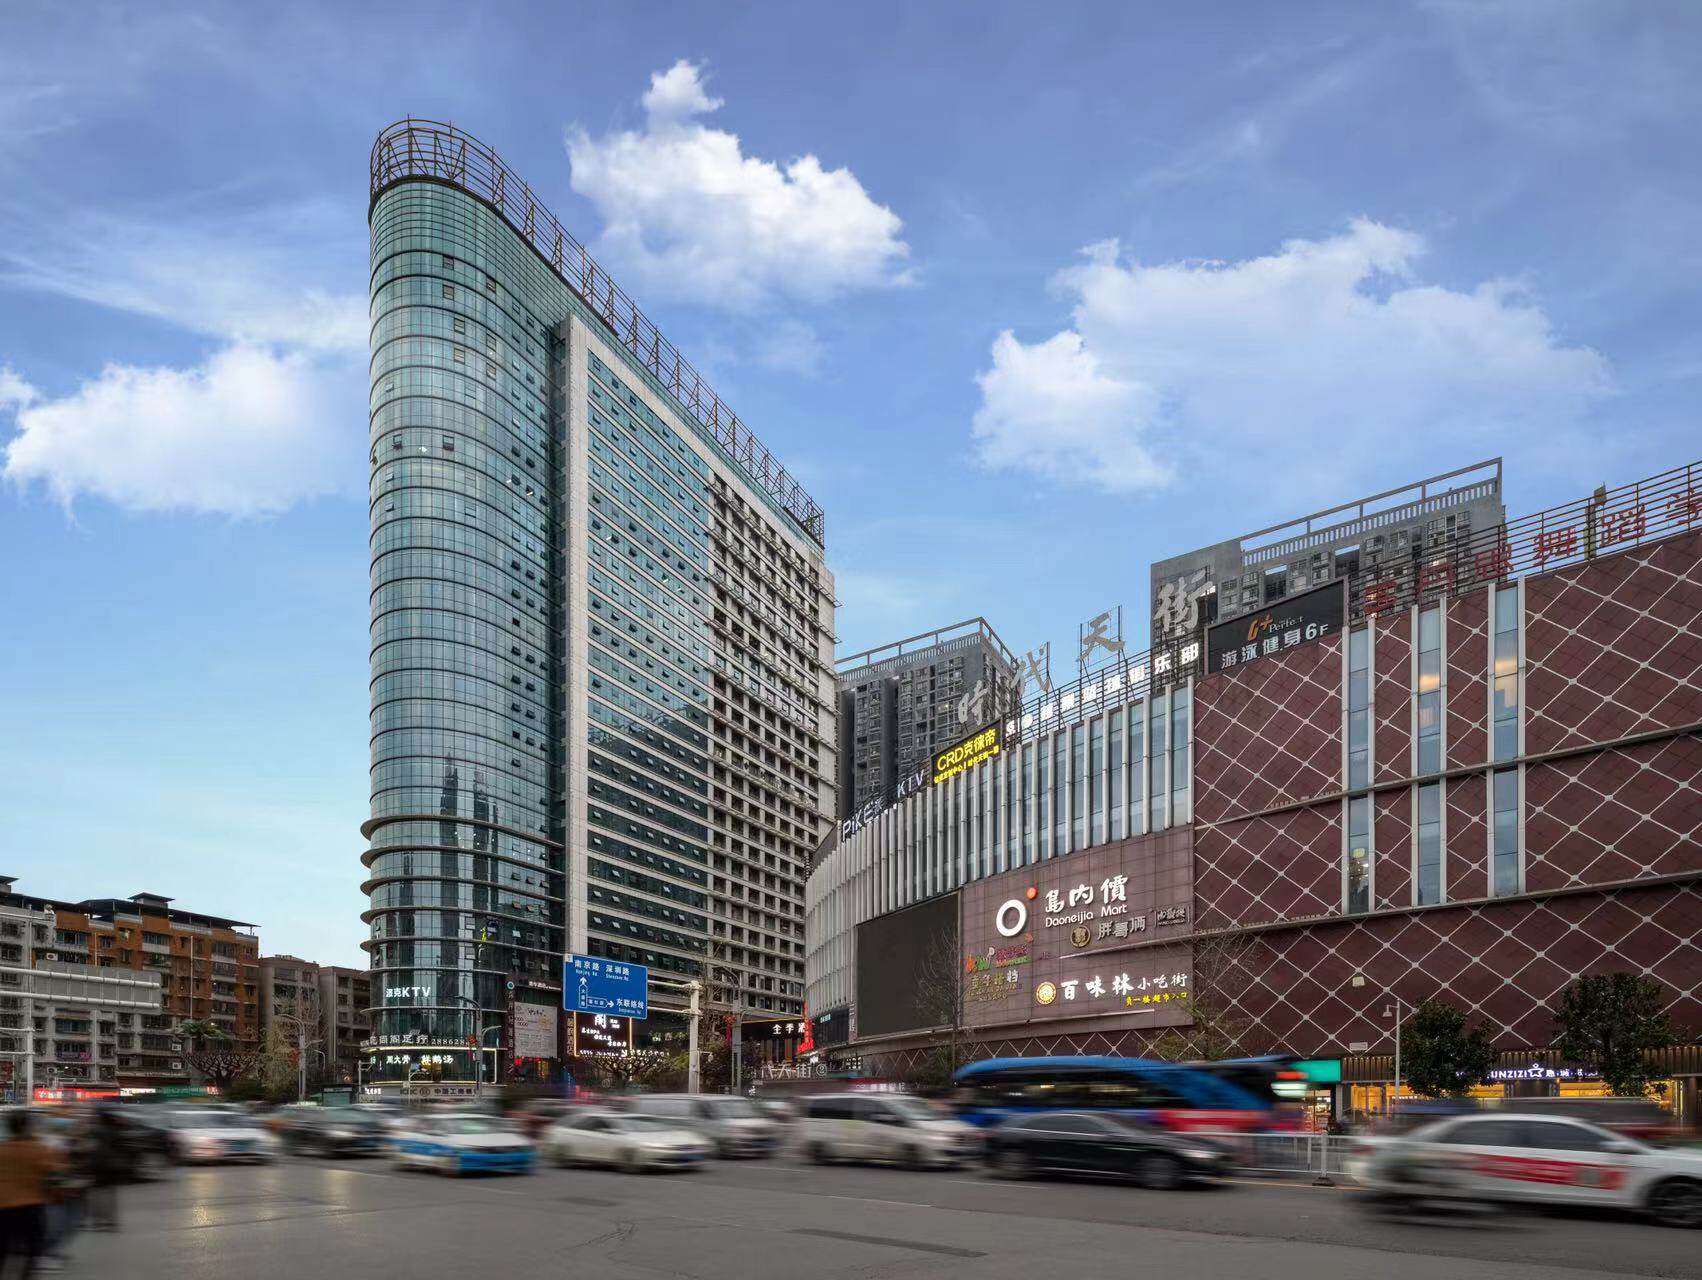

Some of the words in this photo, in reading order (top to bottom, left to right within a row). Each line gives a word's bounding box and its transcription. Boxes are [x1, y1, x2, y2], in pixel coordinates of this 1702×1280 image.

[897, 769, 925, 798] KTV
[1045, 911, 1094, 928] Daoneijia
[1100, 904, 1128, 918] Mart
[574, 960, 600, 971] 南京路
[605, 965, 630, 976] 深圳路
